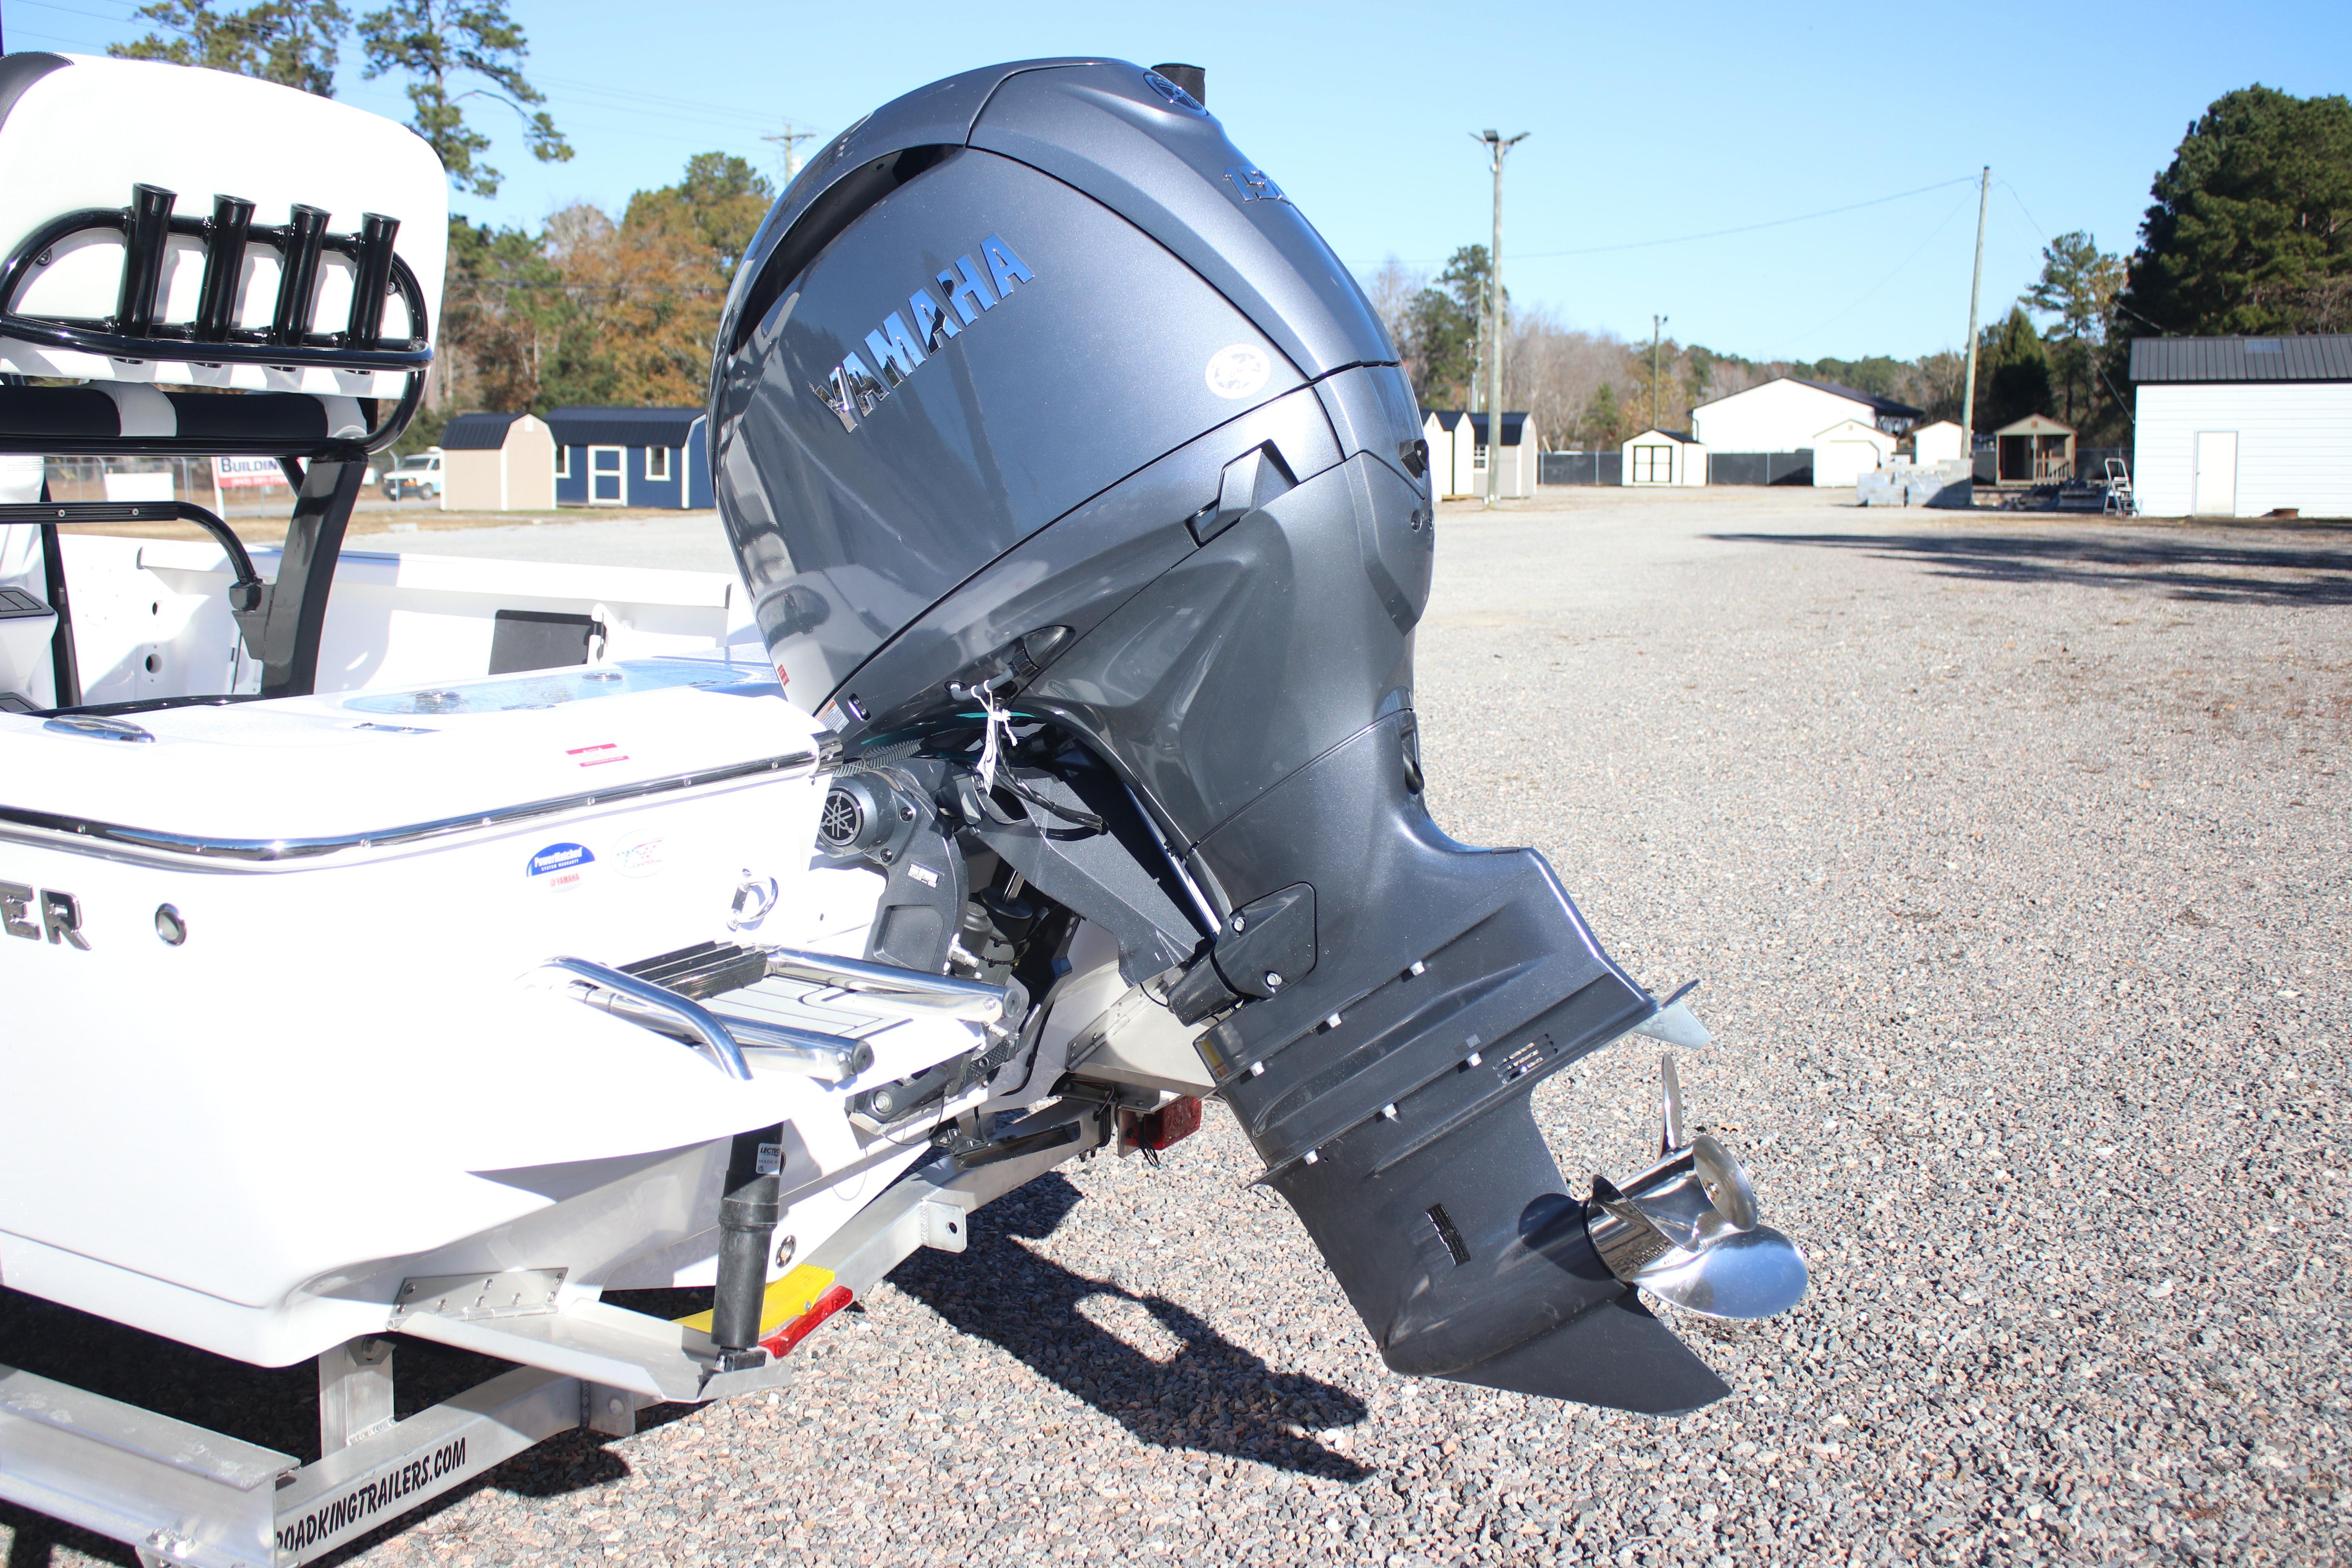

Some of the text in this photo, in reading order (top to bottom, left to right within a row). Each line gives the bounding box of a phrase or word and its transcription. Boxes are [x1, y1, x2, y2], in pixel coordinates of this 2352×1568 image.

[814, 233, 1035, 434] YAMAHA
[221, 457, 281, 472] BUILDIN
[534, 847, 583, 868] PowerMatched
[558, 858, 579, 867] WARRANTY
[556, 873, 580, 886] YAMAHA
